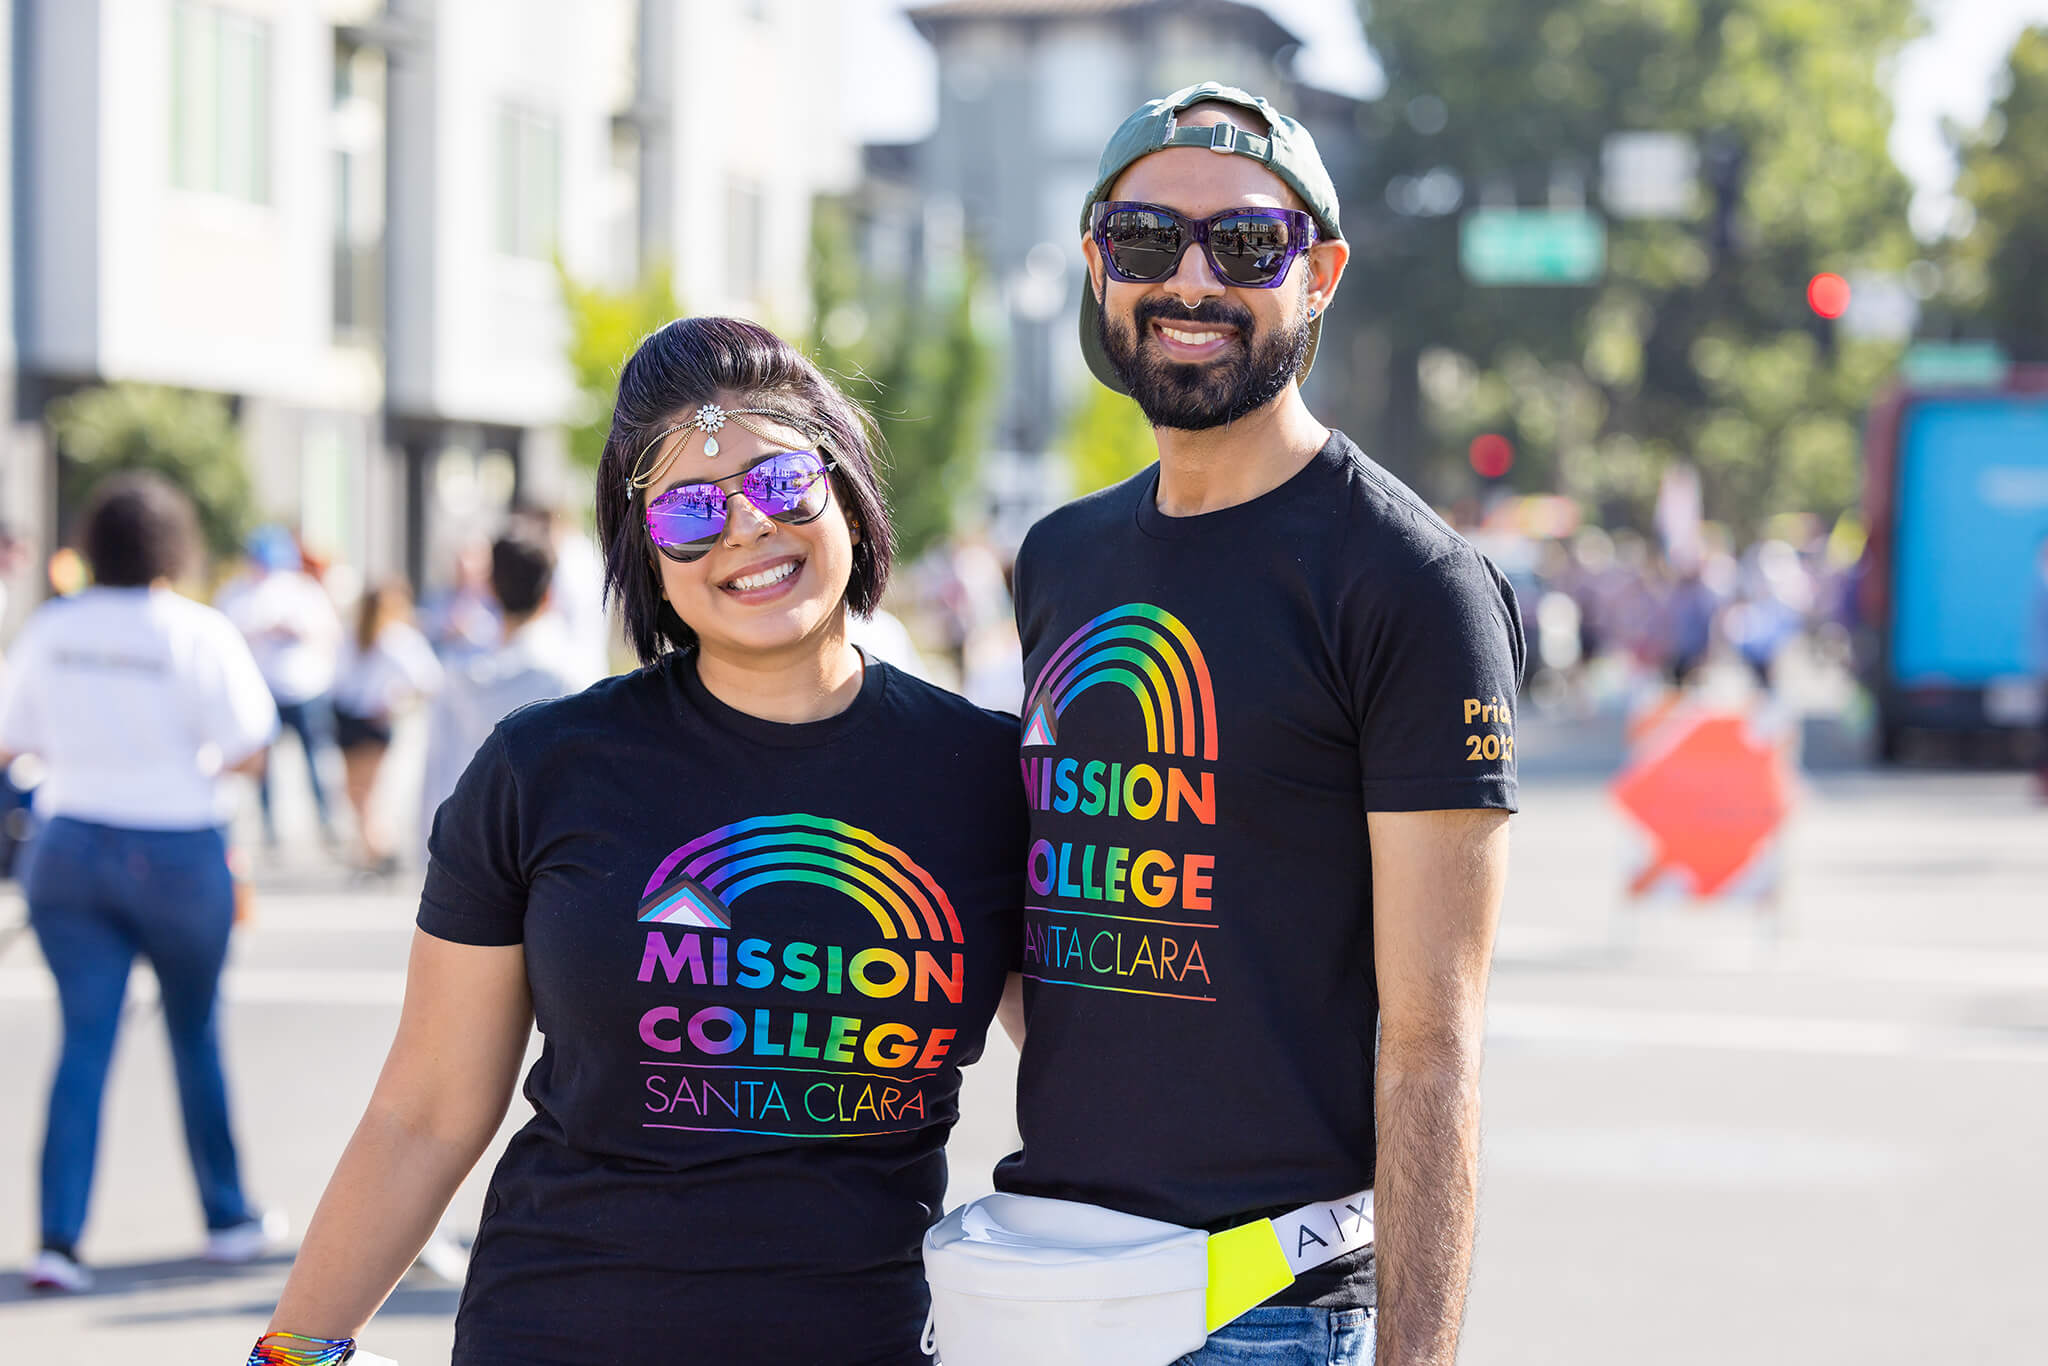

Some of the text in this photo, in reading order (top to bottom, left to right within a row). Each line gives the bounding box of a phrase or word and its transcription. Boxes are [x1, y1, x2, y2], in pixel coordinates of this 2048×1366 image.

[1463, 696, 1512, 724] Prid
[1027, 838, 1216, 911] OLLEGE
[637, 931, 964, 1004] MISSION
[1024, 921, 1211, 985] ANTA CLARA
[638, 1006, 957, 1069] COLLEGE
[645, 1075, 925, 1122] SANTA CLARA
